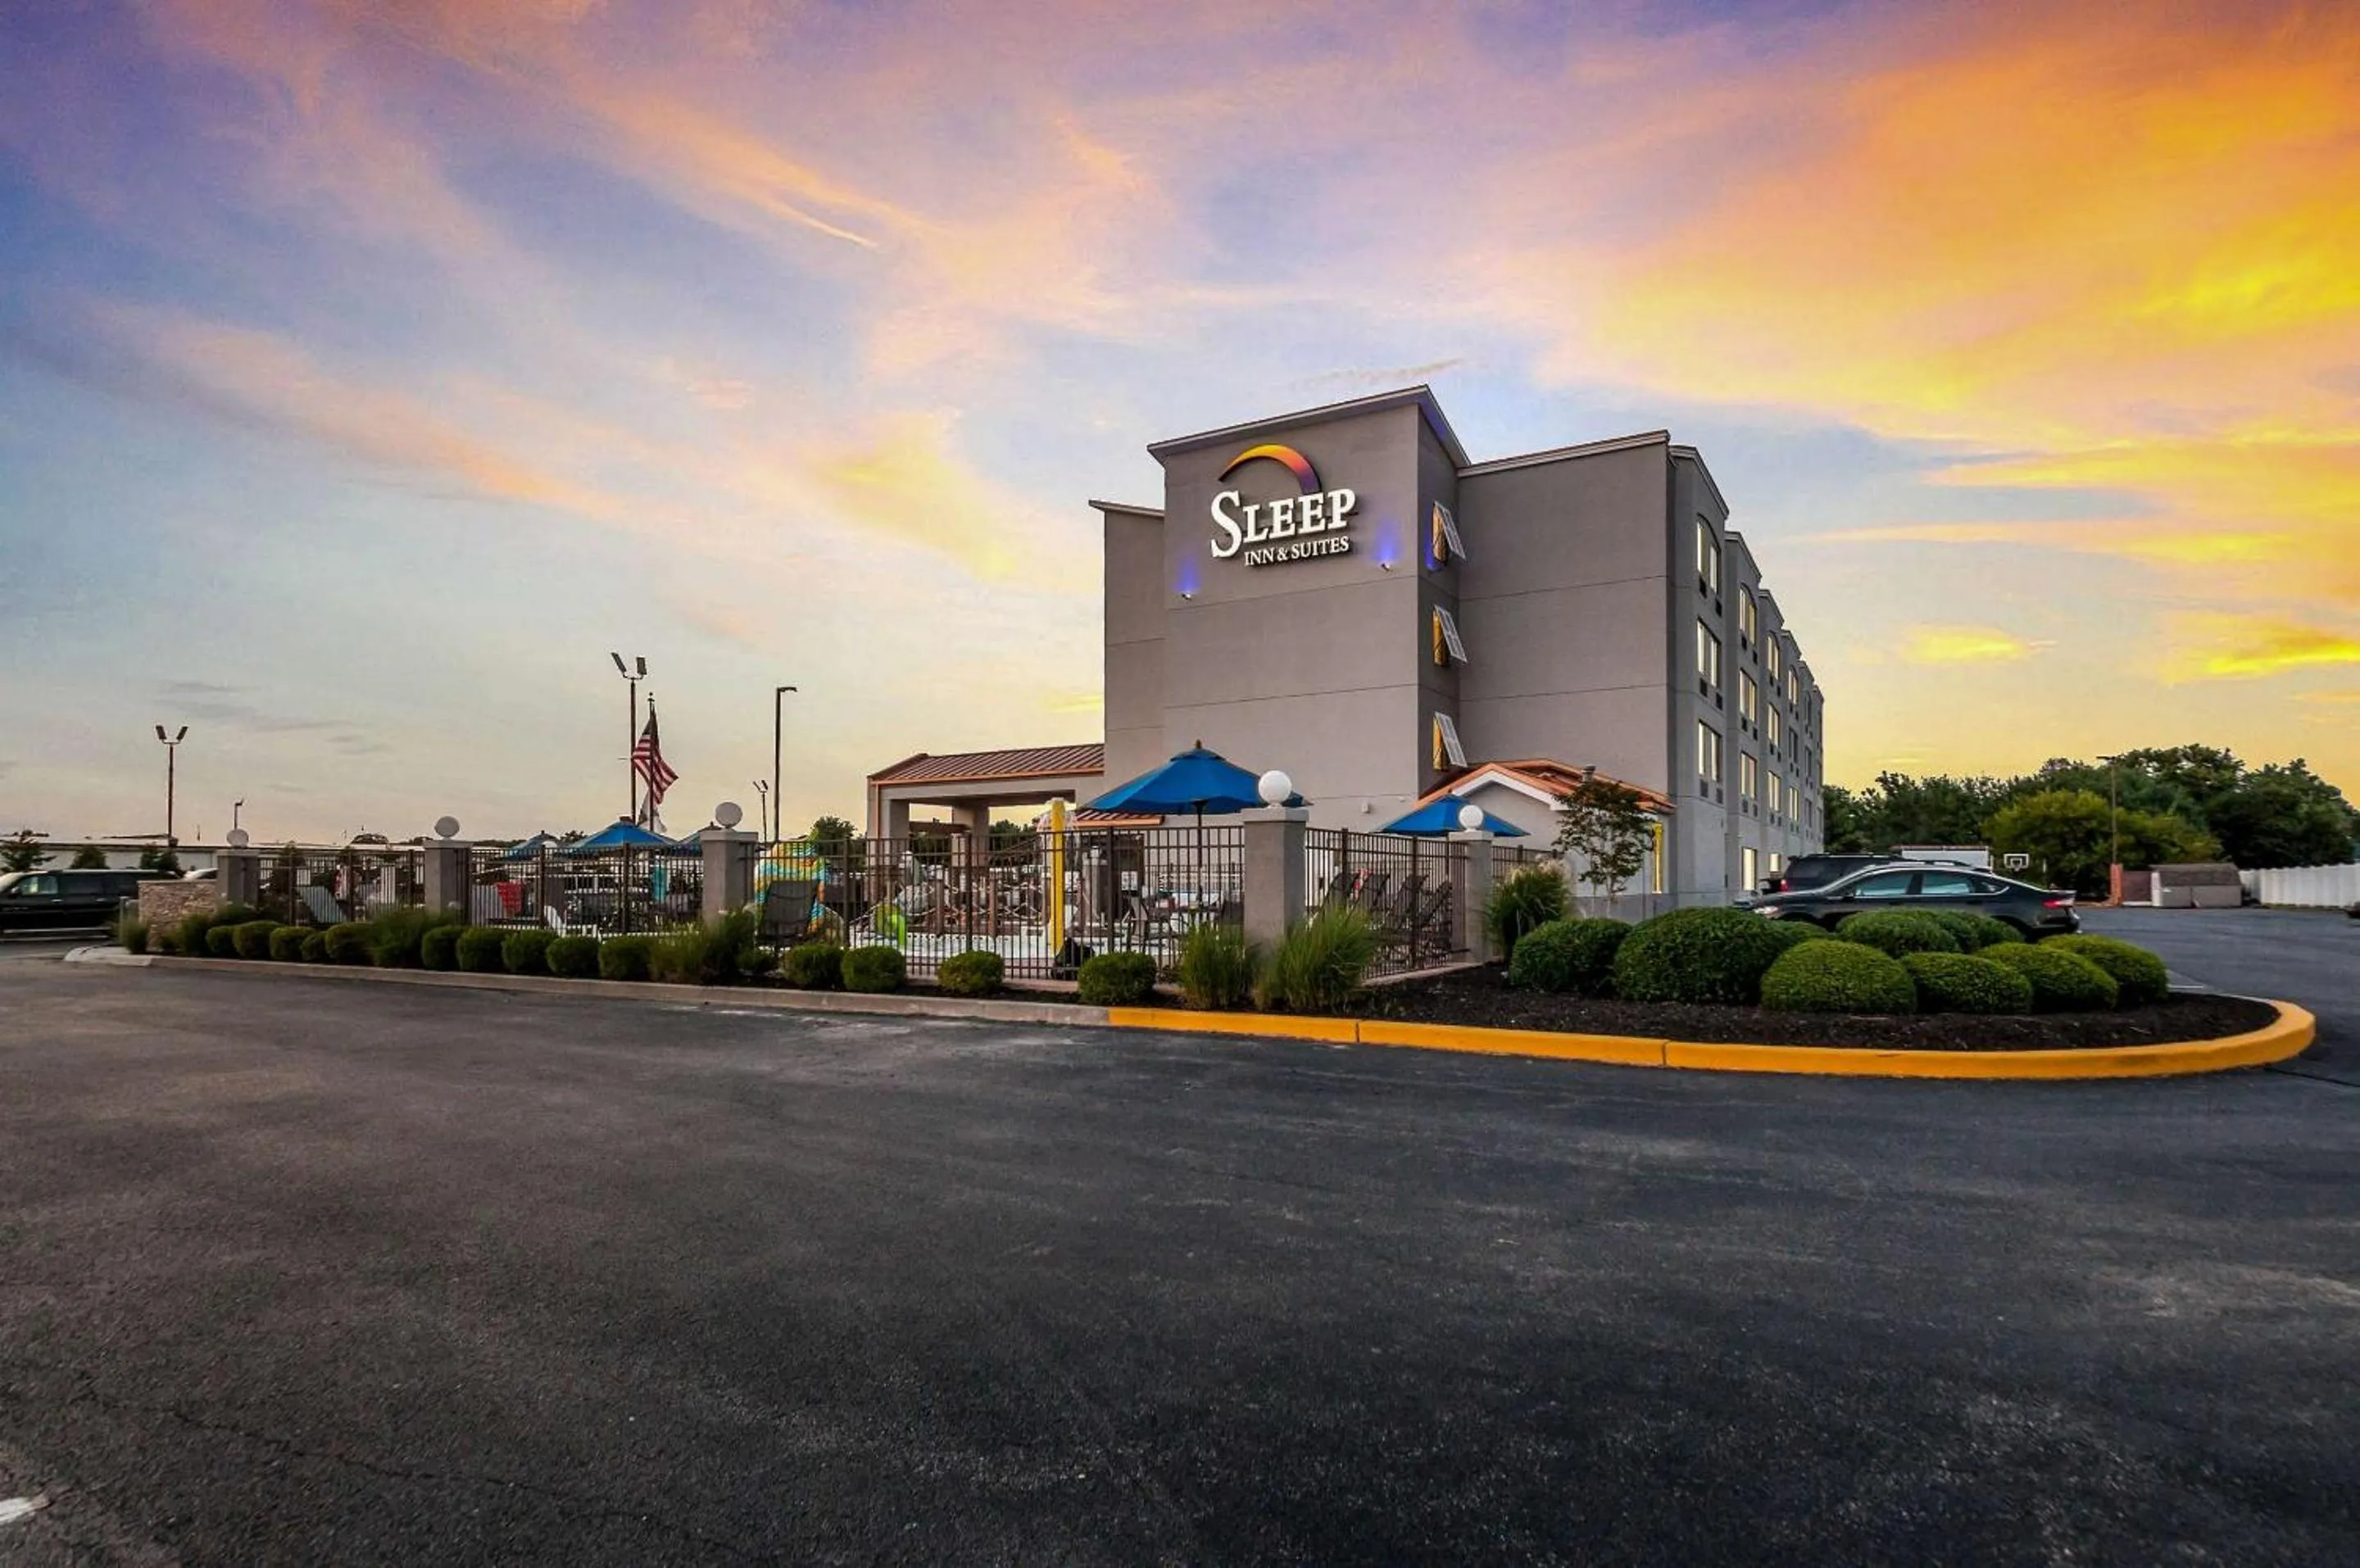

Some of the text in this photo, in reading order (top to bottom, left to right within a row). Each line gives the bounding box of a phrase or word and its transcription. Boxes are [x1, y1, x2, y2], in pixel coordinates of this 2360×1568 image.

[1244, 536, 1350, 567] INN & SUITES
